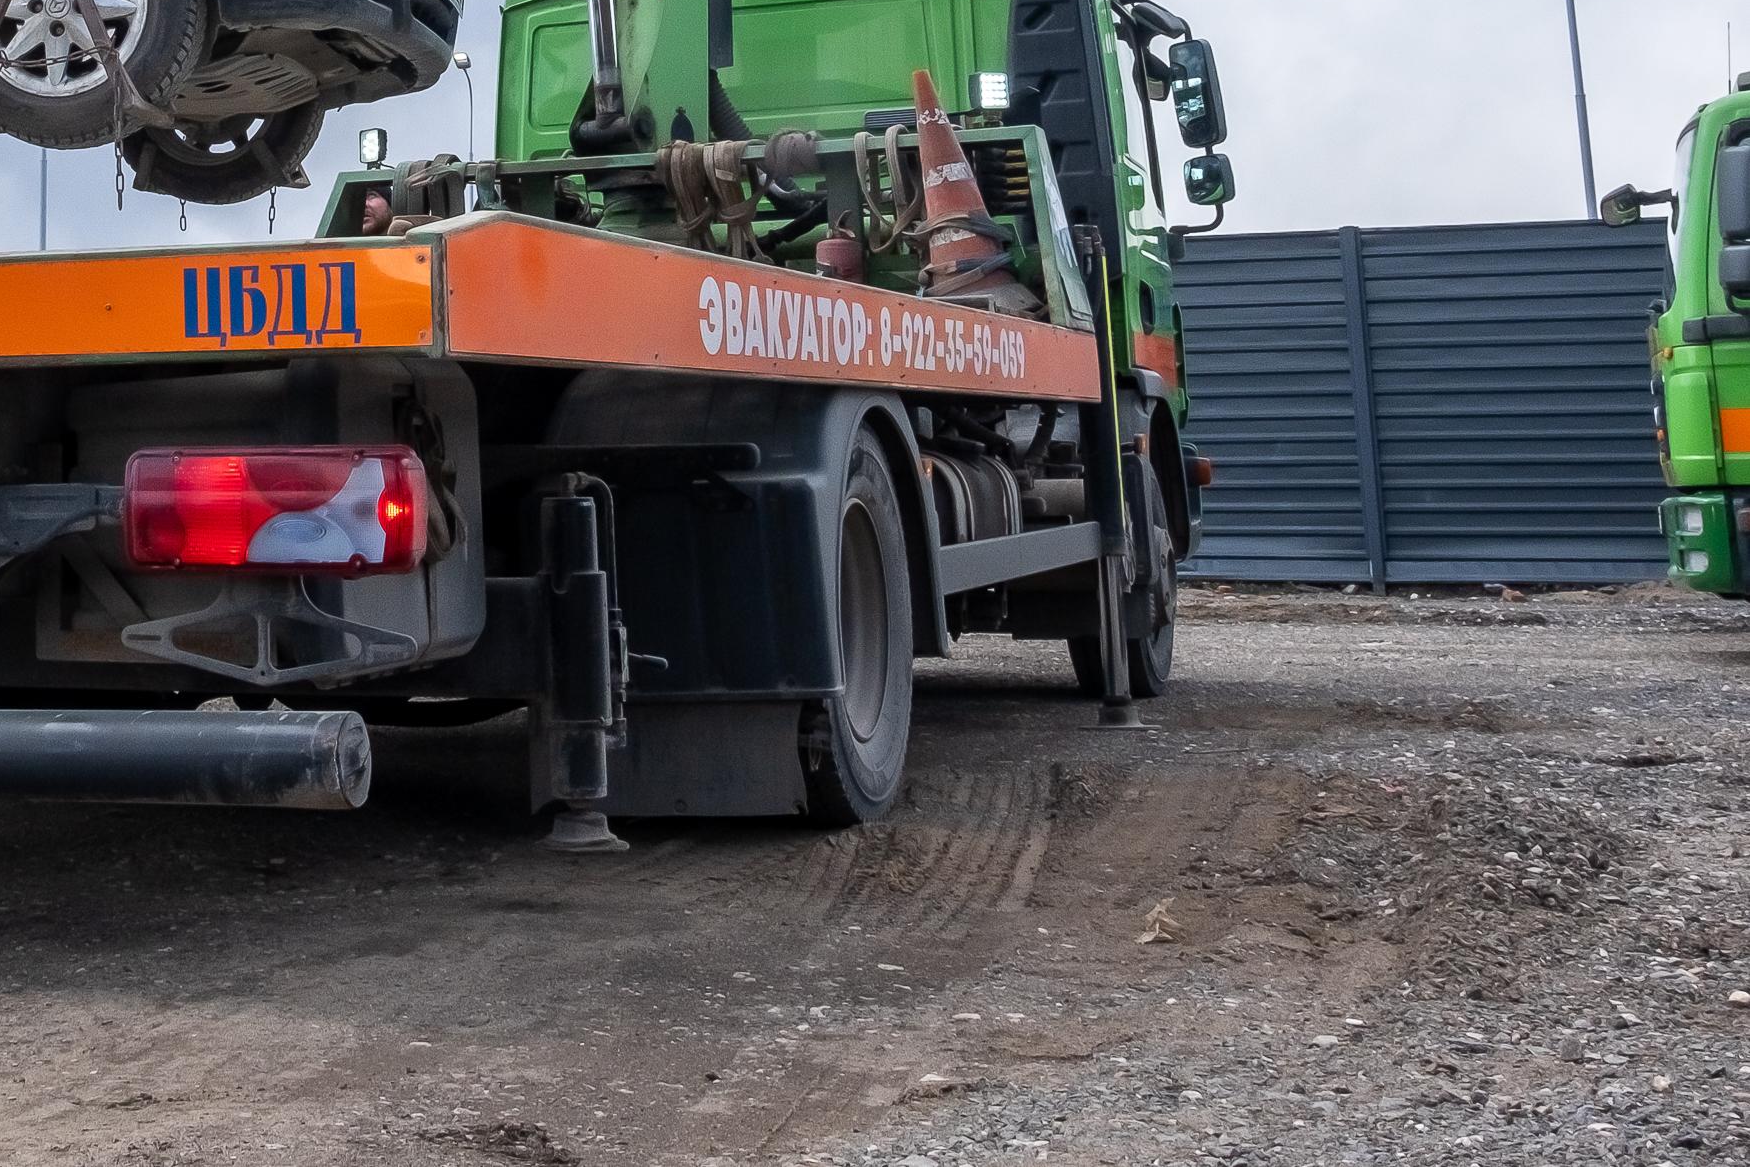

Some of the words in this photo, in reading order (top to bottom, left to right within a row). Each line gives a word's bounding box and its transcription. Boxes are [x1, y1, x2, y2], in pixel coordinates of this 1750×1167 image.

[183, 261, 362, 347] ЦБДД
[699, 276, 873, 366] ЭВАКУАТОР:
[880, 306, 1025, 379] 8-922-35-59-059
